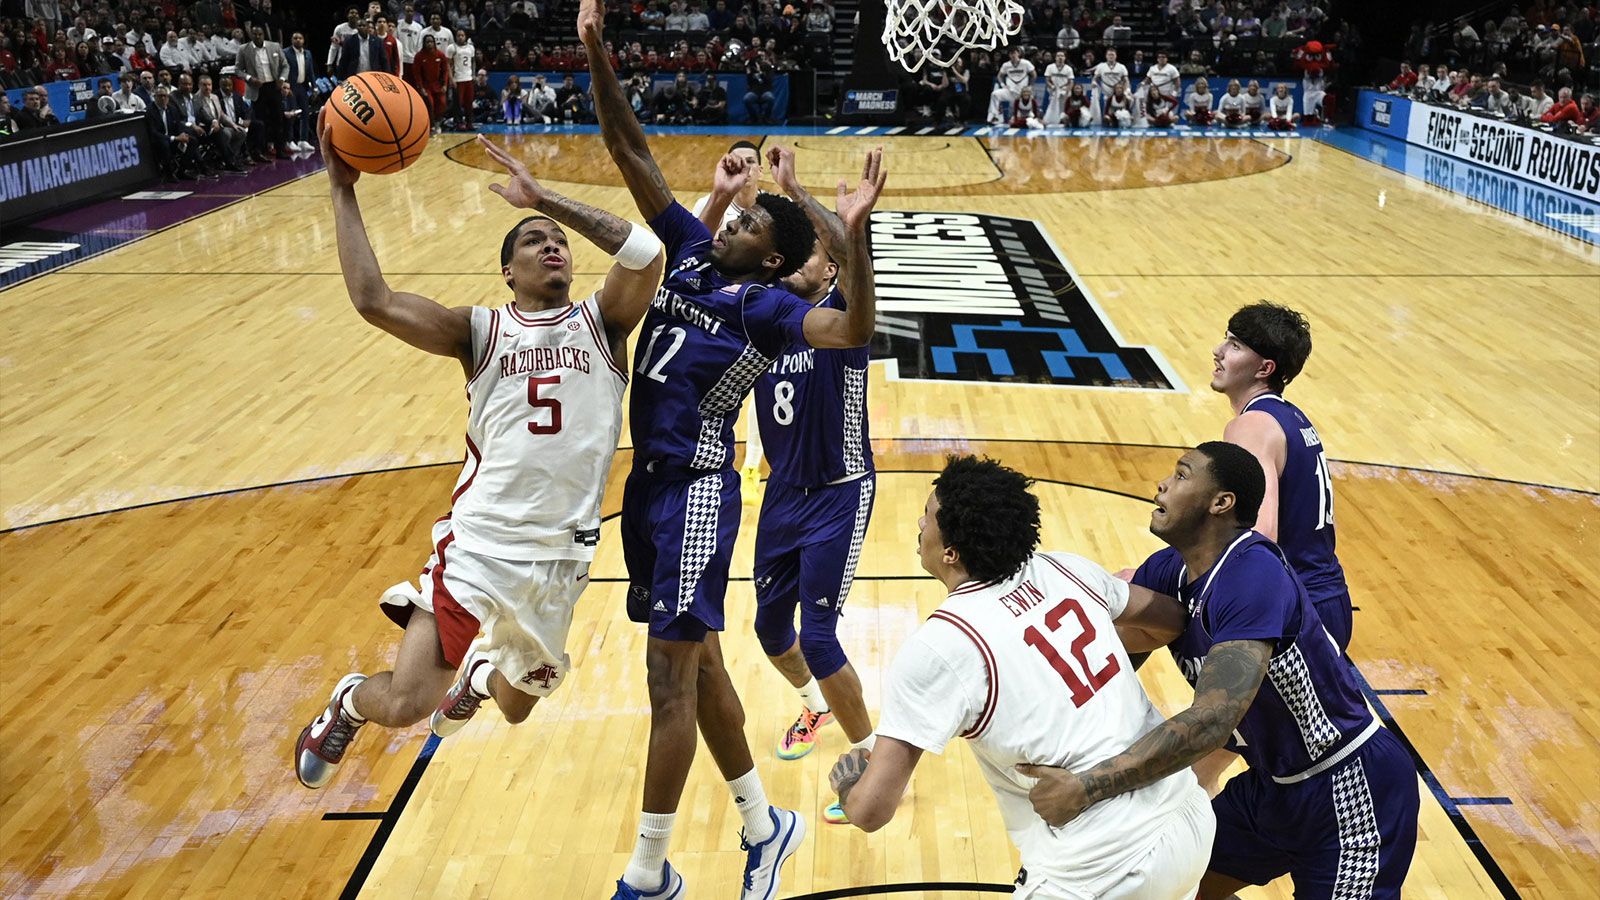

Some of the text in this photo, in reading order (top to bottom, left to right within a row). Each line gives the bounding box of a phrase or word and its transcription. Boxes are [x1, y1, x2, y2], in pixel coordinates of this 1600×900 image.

[338, 80, 375, 126] Wilson
[855, 92, 883, 101] MARCH
[858, 101, 896, 110] MADNESS
[1426, 111, 1461, 152] FIRST
[1469, 123, 1525, 172] SECOND
[1526, 136, 1600, 195] ROUNDS
[870, 212, 1025, 316] MADNESS
[671, 293, 726, 336] POINT
[499, 346, 590, 379] RAZORBACKS
[636, 323, 686, 384] 12
[780, 348, 815, 374] POIN
[528, 375, 562, 435] 5
[773, 380, 795, 426] 8
[999, 579, 1045, 618] EWIN
[1023, 598, 1121, 709] 12
